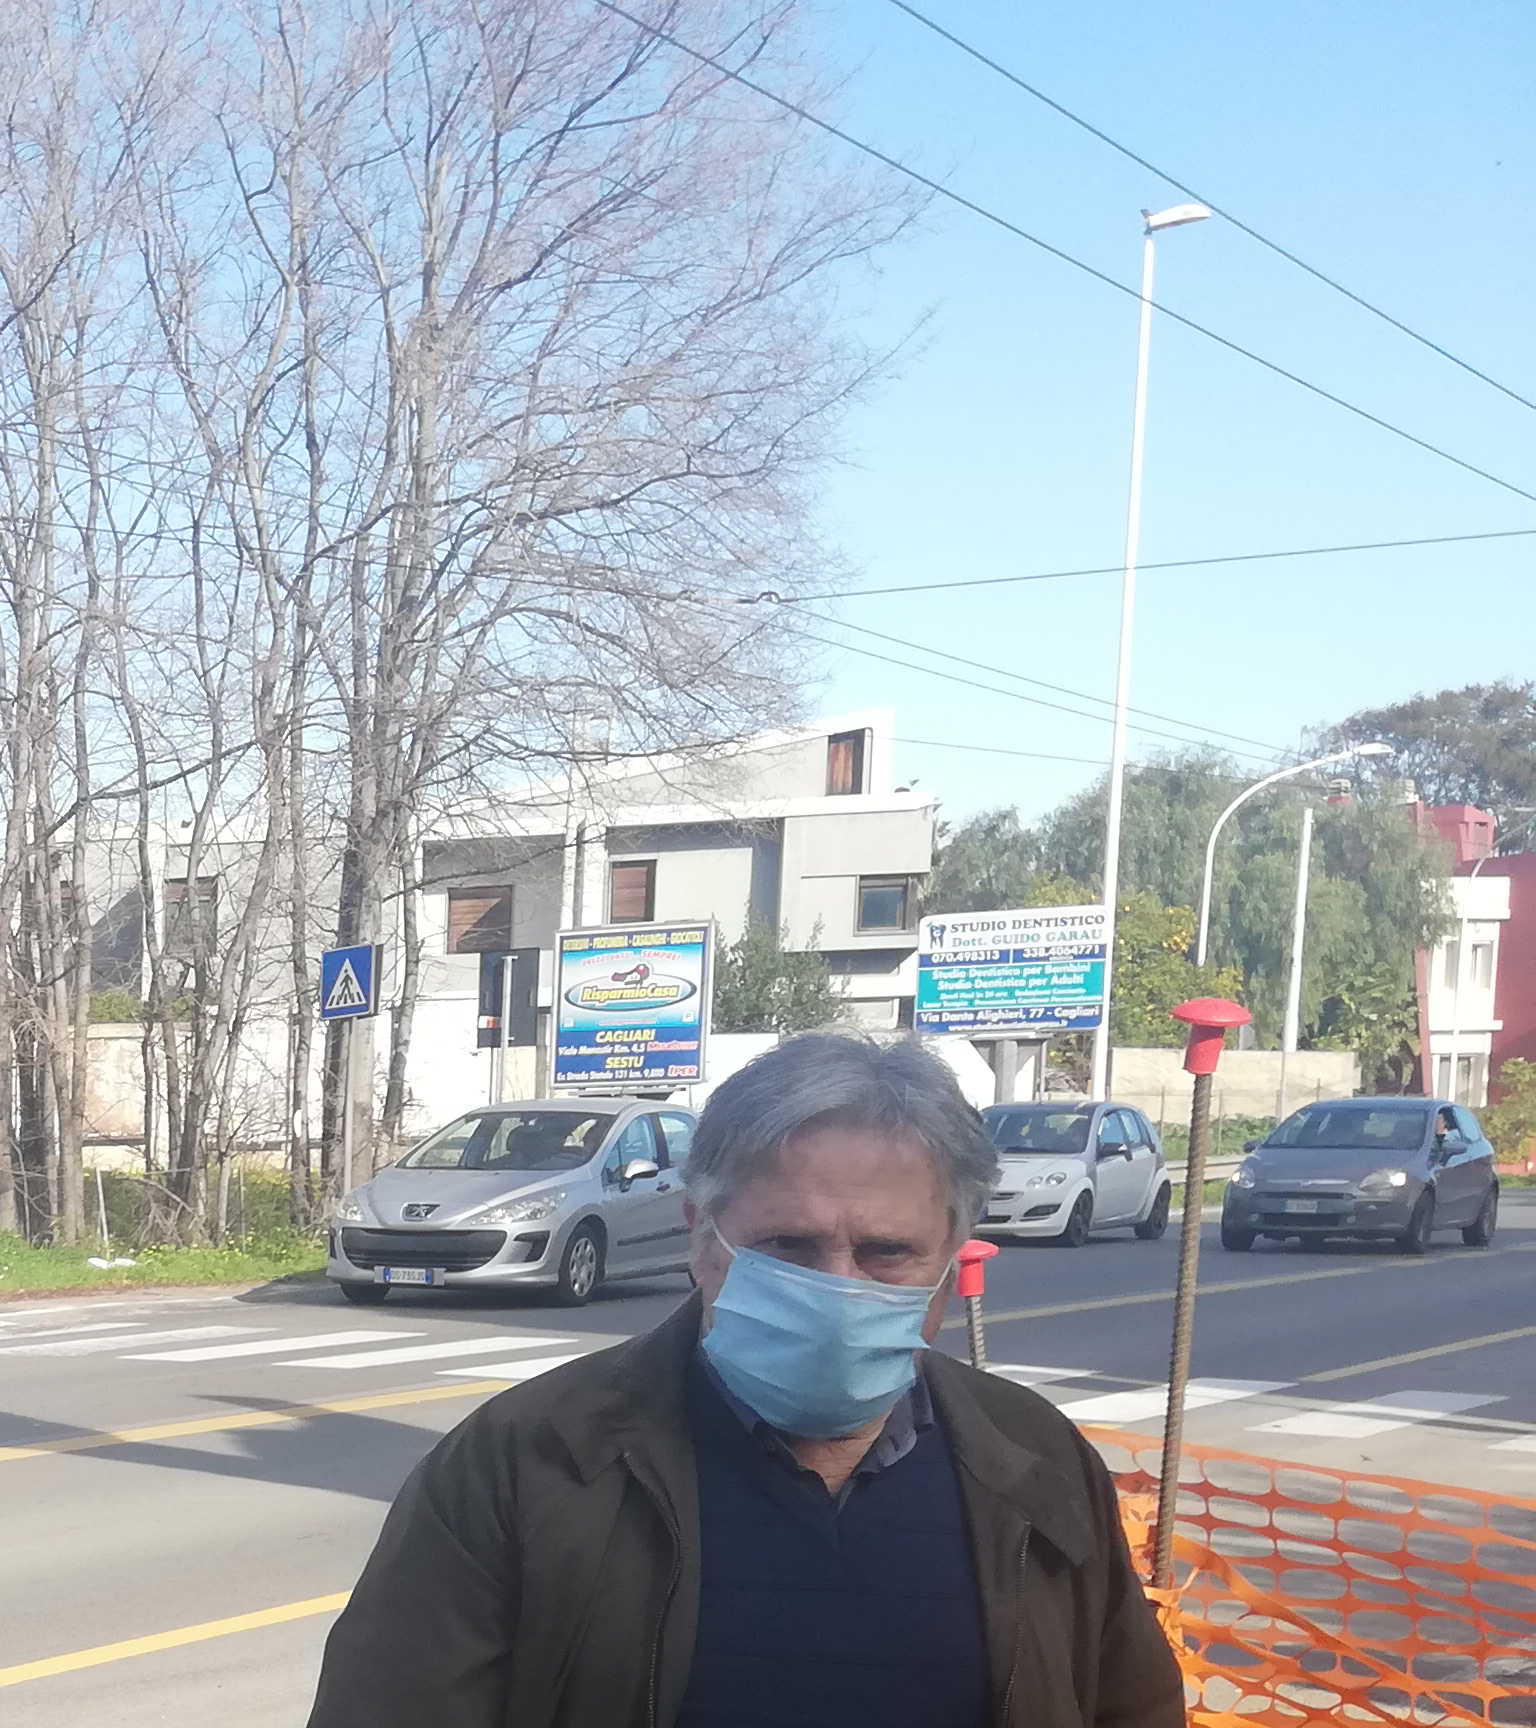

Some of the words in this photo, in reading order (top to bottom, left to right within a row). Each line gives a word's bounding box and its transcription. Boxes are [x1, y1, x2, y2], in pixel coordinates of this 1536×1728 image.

[950, 920, 1007, 933] STUDIO
[1011, 914, 1105, 930] DENTISTICO
[951, 936, 988, 948] Dott.
[991, 932, 1041, 946] GUIDO
[1045, 928, 1103, 942] GARAU
[932, 967, 967, 980] Studio
[968, 966, 1021, 979] Dentistico
[1023, 966, 1043, 978] per
[937, 979, 972, 991] Studio
[974, 976, 1027, 989] Dentistico
[1028, 977, 1048, 988] per
[921, 1012, 940, 1022] Via
[941, 1012, 975, 1022] Dante
[976, 1009, 1027, 1022] Alighieri,
[1029, 1007, 1045, 1018] 77
[1054, 1005, 1099, 1019] Cagliari
[596, 1029, 656, 1043] CAGLIARI
[605, 1056, 645, 1068] SESTU
